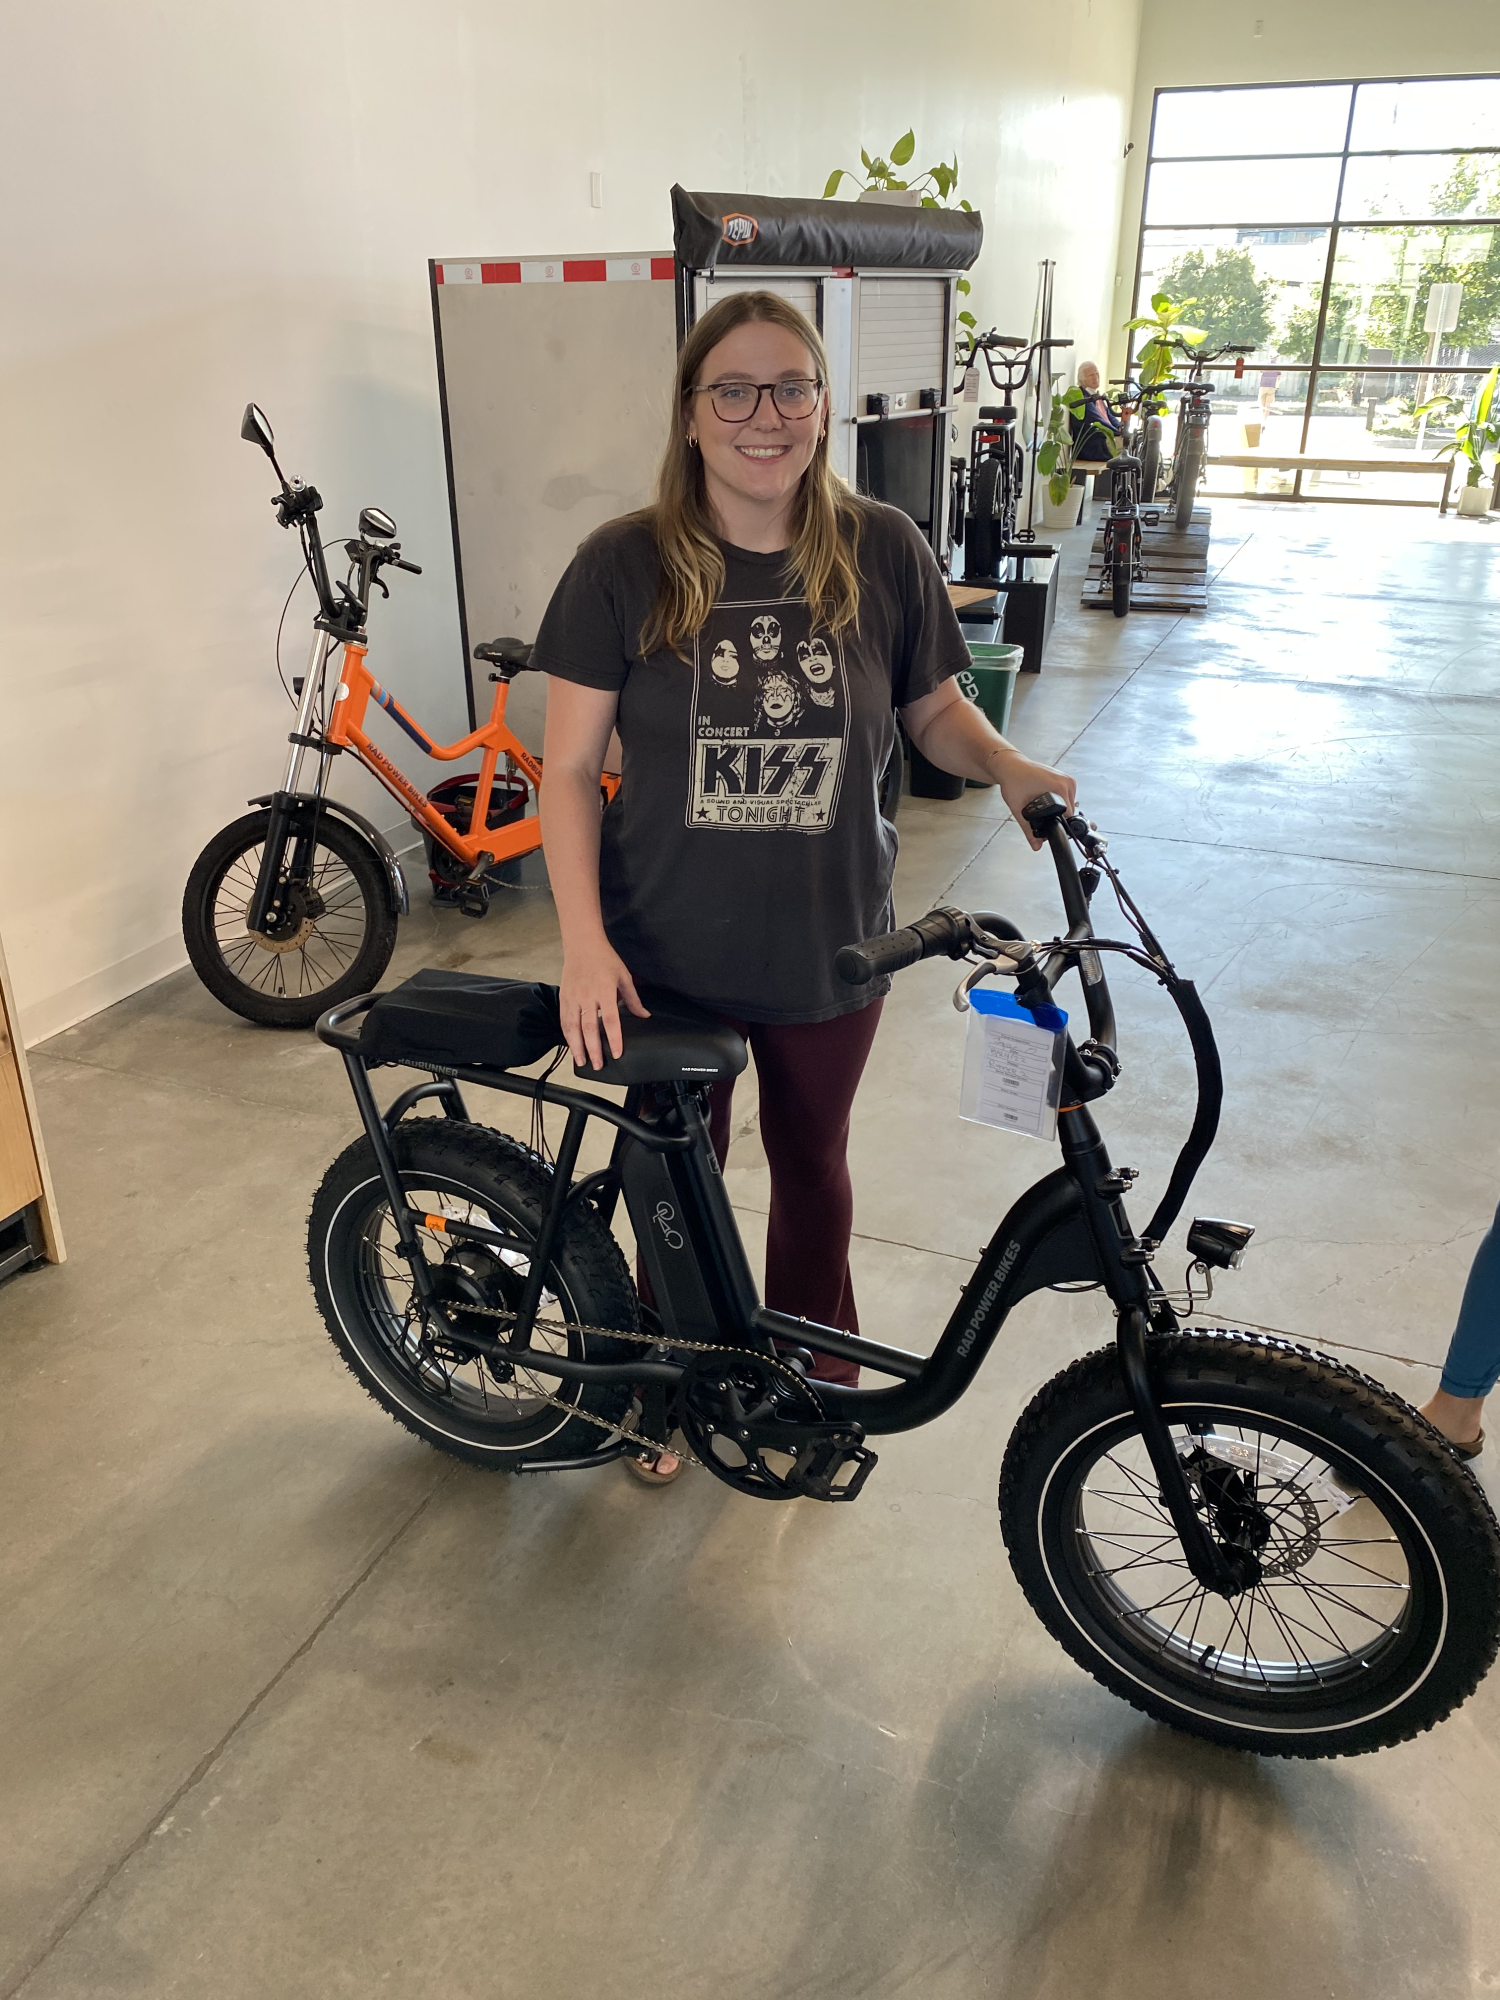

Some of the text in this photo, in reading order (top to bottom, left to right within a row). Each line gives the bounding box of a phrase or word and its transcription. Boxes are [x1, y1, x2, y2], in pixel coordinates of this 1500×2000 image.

[697, 715, 711, 726] IN
[697, 726, 750, 737] CONCERT
[366, 742, 428, 808] RAD POWER BIKES
[701, 743, 833, 798] KISS
[716, 805, 806, 824] TONIGHT
[956, 1239, 1021, 1358] RAD POWER BIKES
